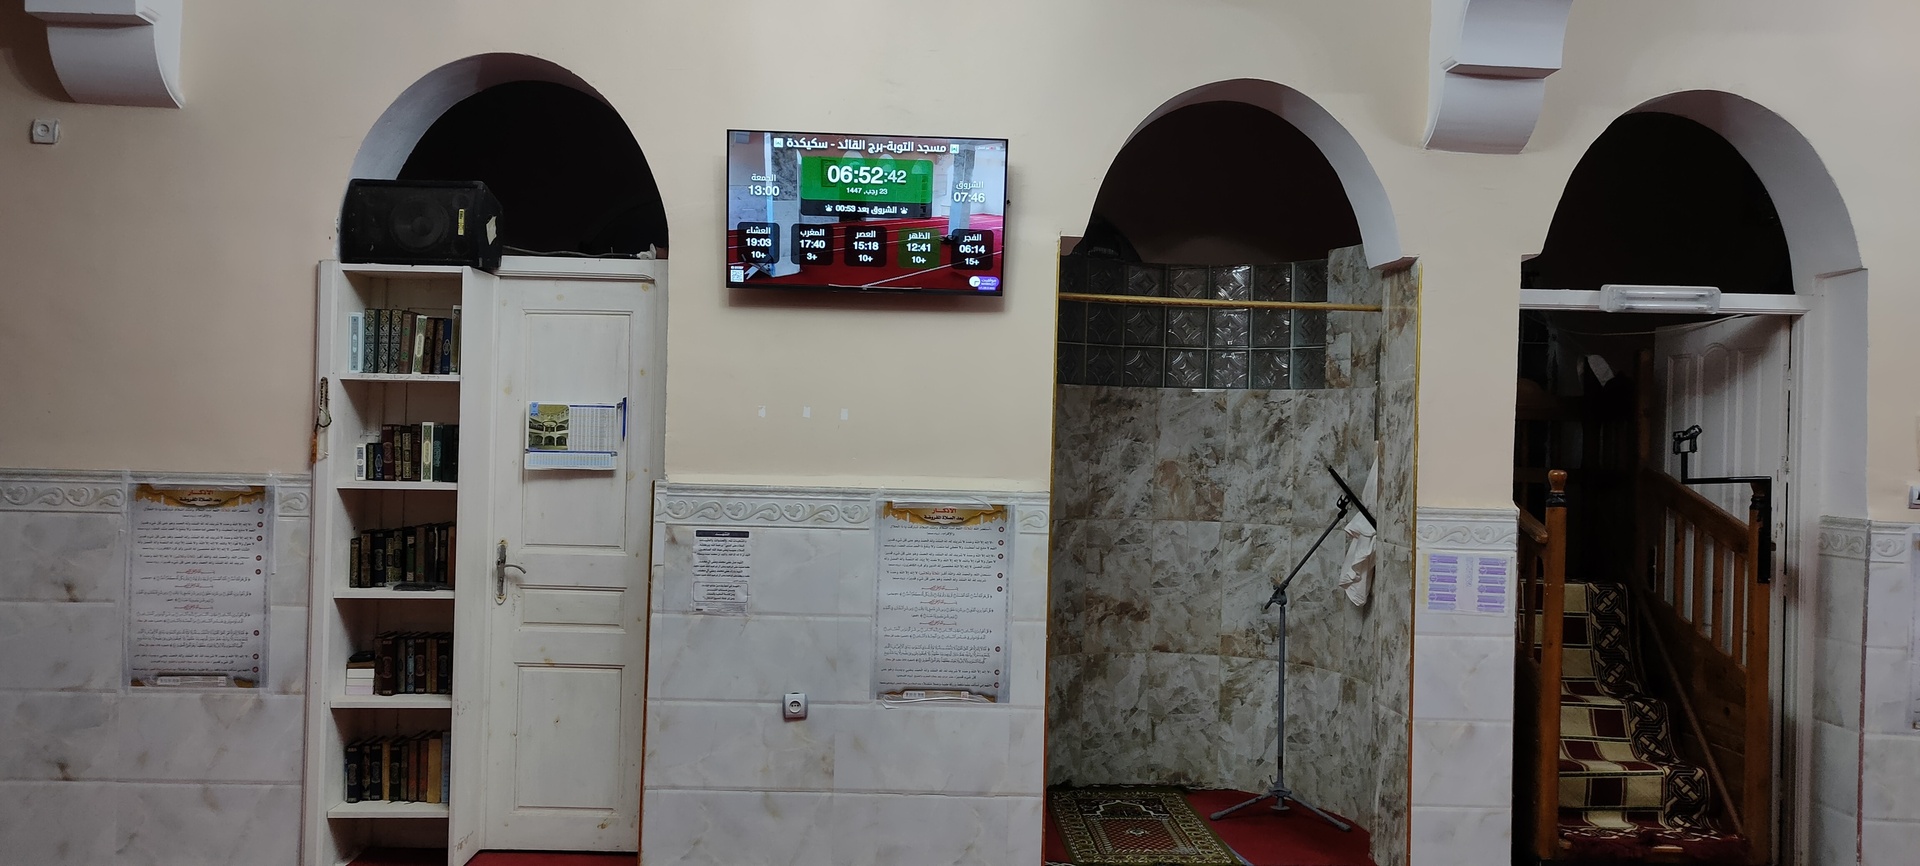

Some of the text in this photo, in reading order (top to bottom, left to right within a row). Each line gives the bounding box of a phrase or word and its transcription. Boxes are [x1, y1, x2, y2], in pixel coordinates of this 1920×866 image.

[786, 137, 829, 150] سكيكدة
[837, 138, 866, 151] القائد
[916, 141, 947, 153] مسجد
[751, 173, 777, 182] الجمعة
[955, 181, 985, 190] الشروق
[748, 185, 780, 196] 13:00
[953, 191, 986, 203] 07:46
[835, 204, 897, 215] الشروق بعد 00:53
[746, 226, 771, 235] العشاء
[799, 229, 825, 238] المغرب
[854, 230, 876, 239] العصر
[907, 232, 931, 240] الظهر
[962, 233, 982, 243] الفجر
[745, 238, 772, 247] 19:03
[799, 240, 826, 249] 17:40
[852, 241, 879, 251] 15:18
[906, 243, 931, 252] 12:41
[958, 244, 986, 254] 06:14
